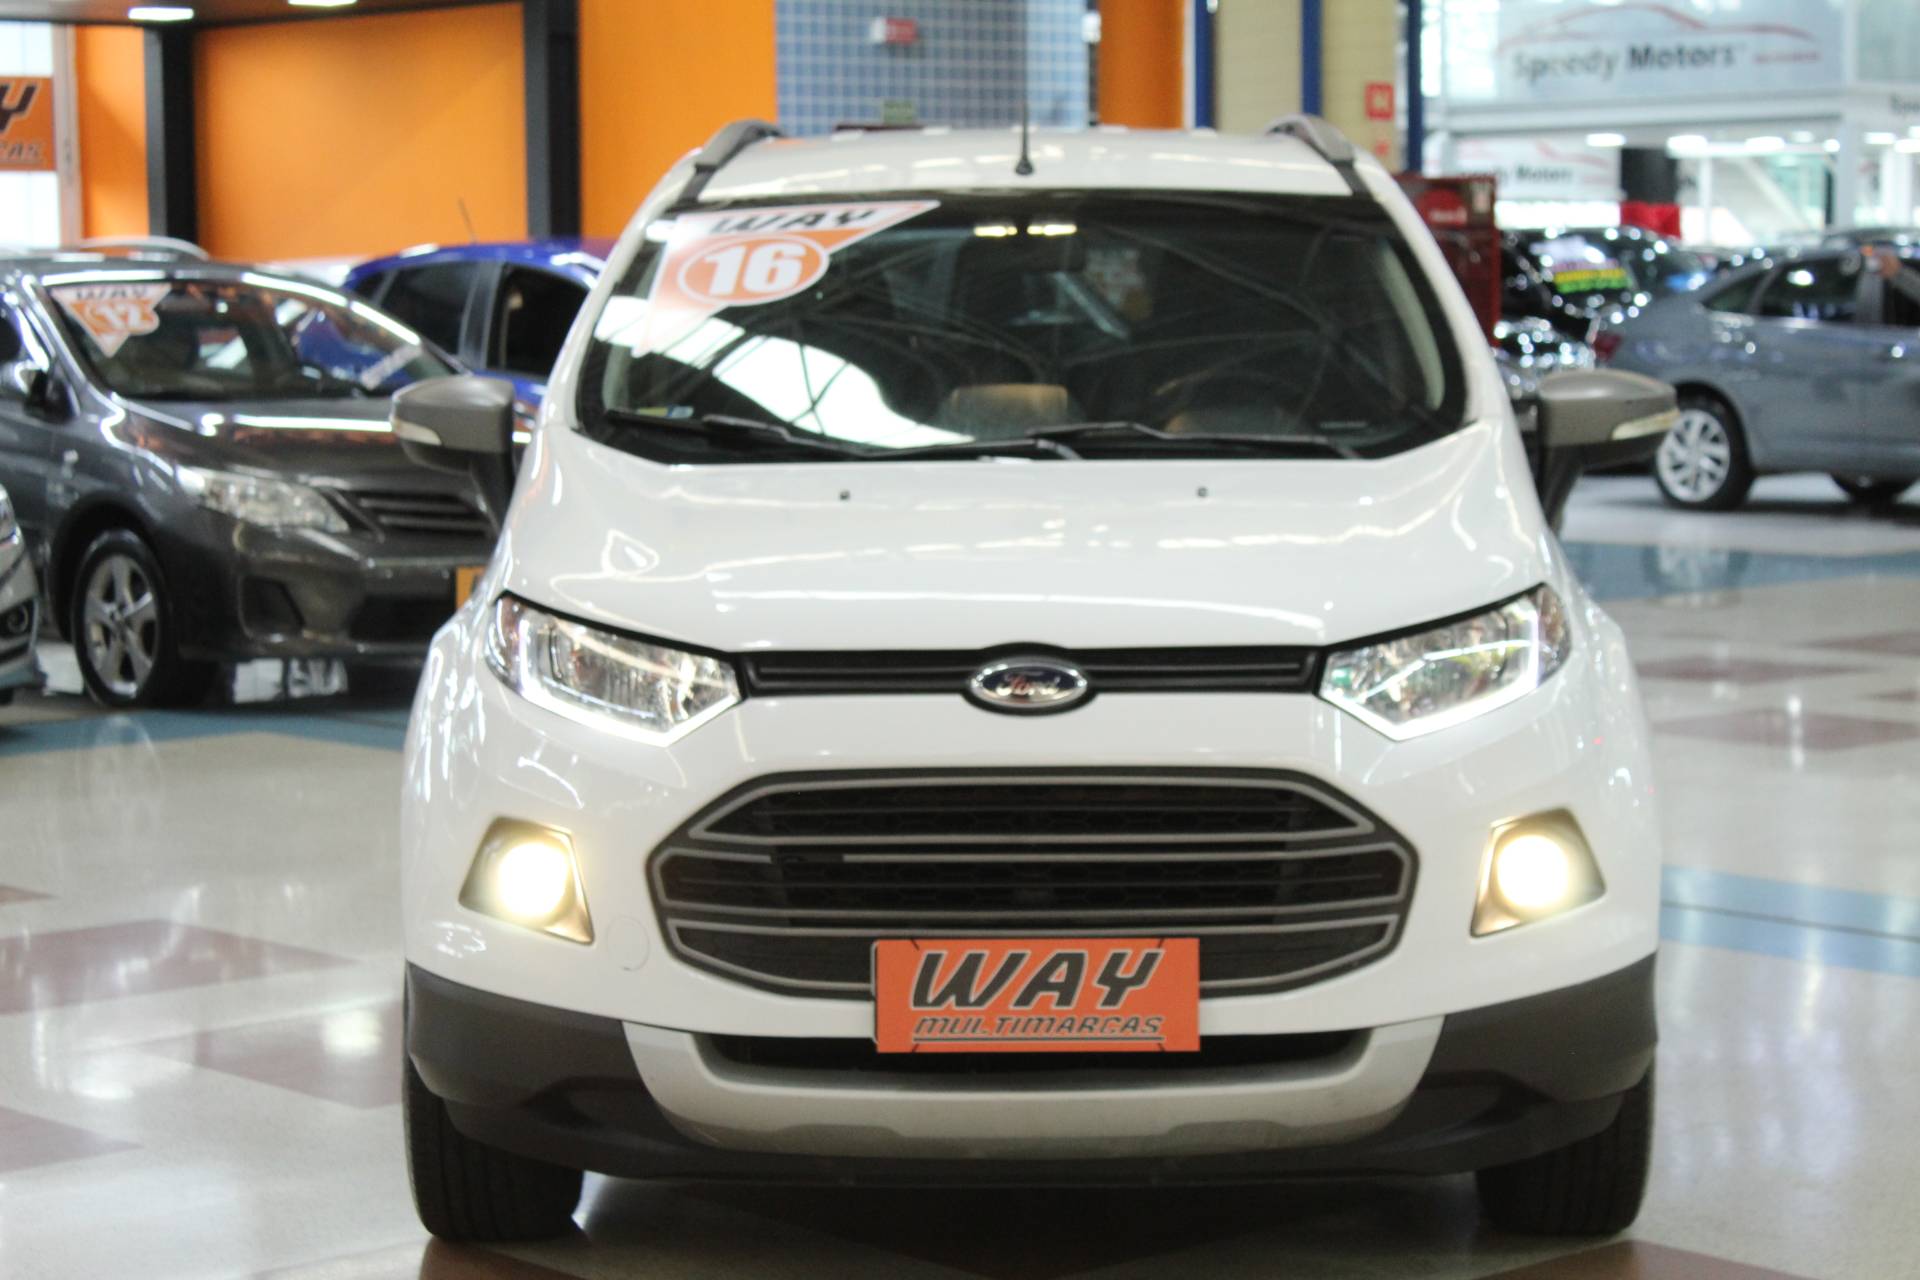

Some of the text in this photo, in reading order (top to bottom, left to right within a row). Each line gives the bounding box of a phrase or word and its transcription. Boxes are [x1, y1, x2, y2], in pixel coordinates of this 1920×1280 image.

[1510, 50, 1617, 84] Speedy
[1627, 45, 1737, 71] Motors
[710, 209, 876, 234] WAY
[703, 242, 807, 296] 16
[911, 949, 1165, 1011] WAY
[914, 1015, 1165, 1035] MULTIMARCAS
